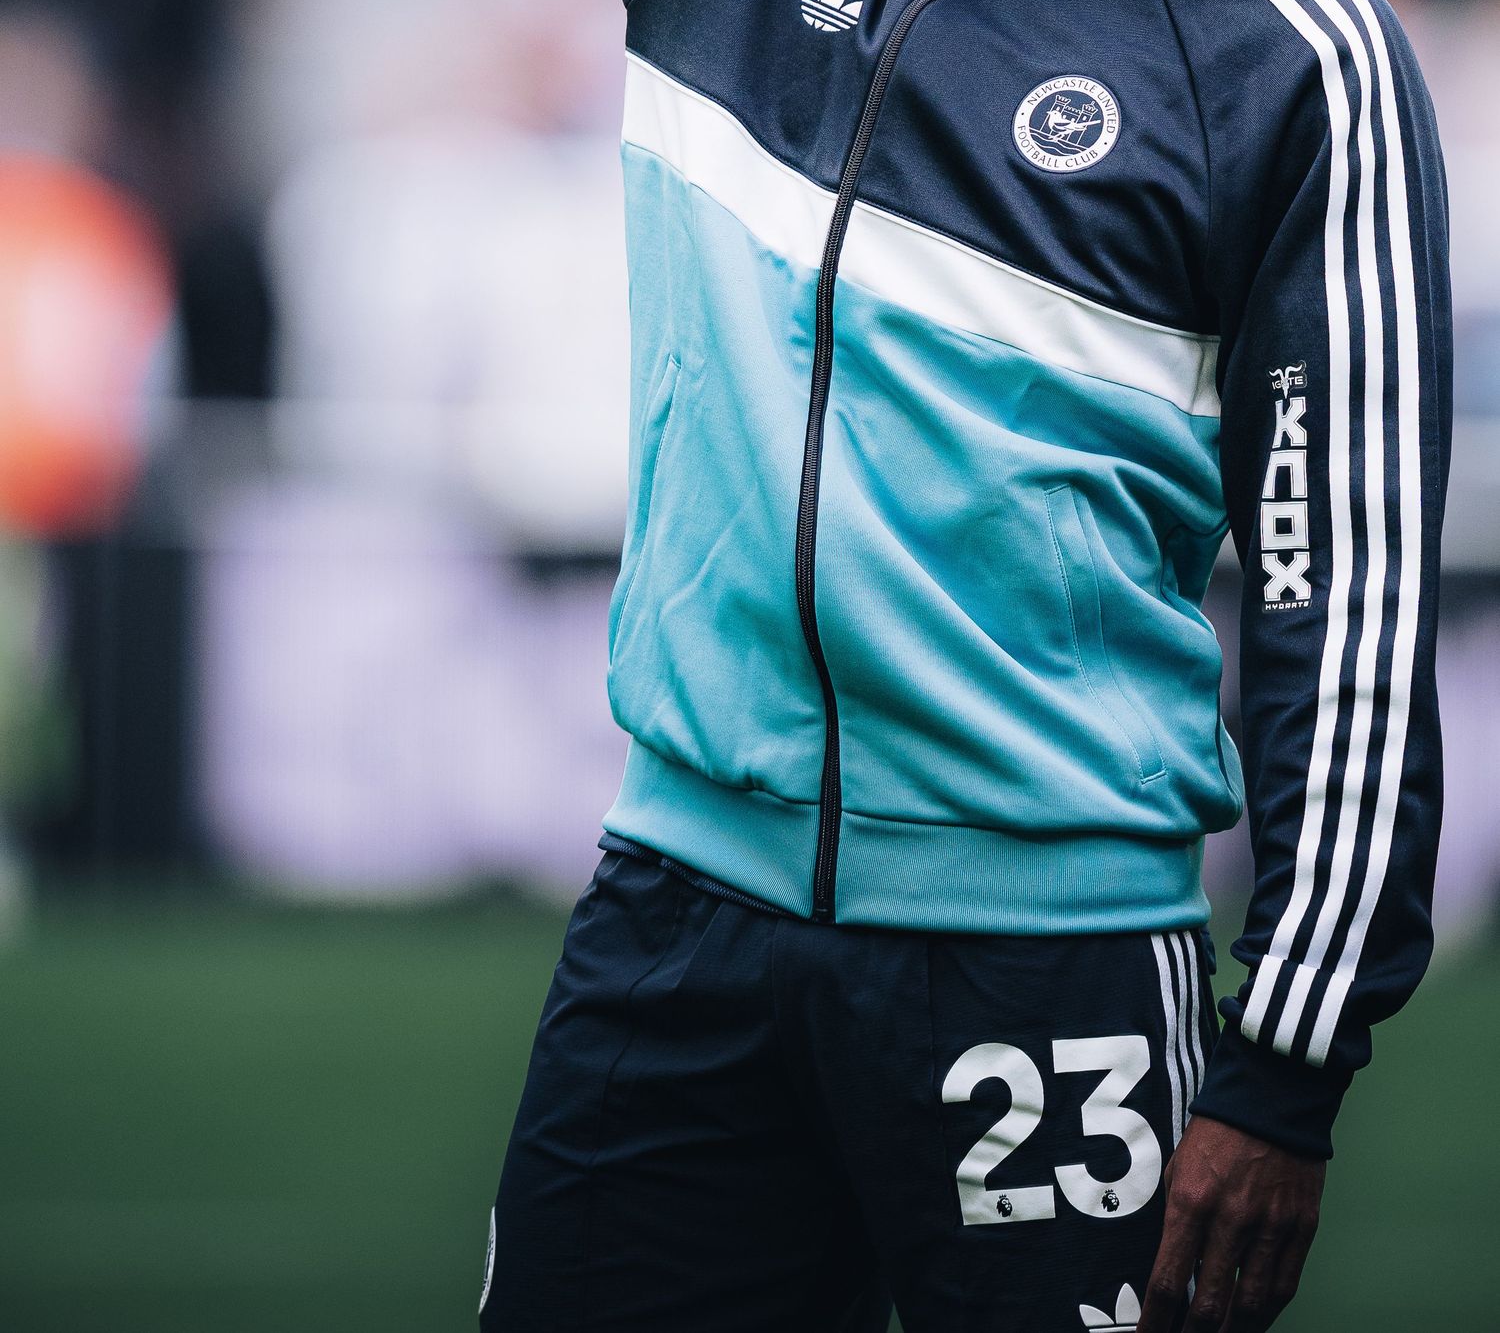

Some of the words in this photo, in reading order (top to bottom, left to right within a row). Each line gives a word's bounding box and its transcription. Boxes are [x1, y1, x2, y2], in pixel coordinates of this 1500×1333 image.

[1027, 79, 1097, 106] NEWCASTLE
[1097, 91, 1117, 134] UNITED
[1018, 125, 1059, 168] FOOTBALL
[1065, 149, 1098, 168] CLUB
[1272, 376, 1304, 390] IGTE
[942, 1035, 1162, 1226] 23
